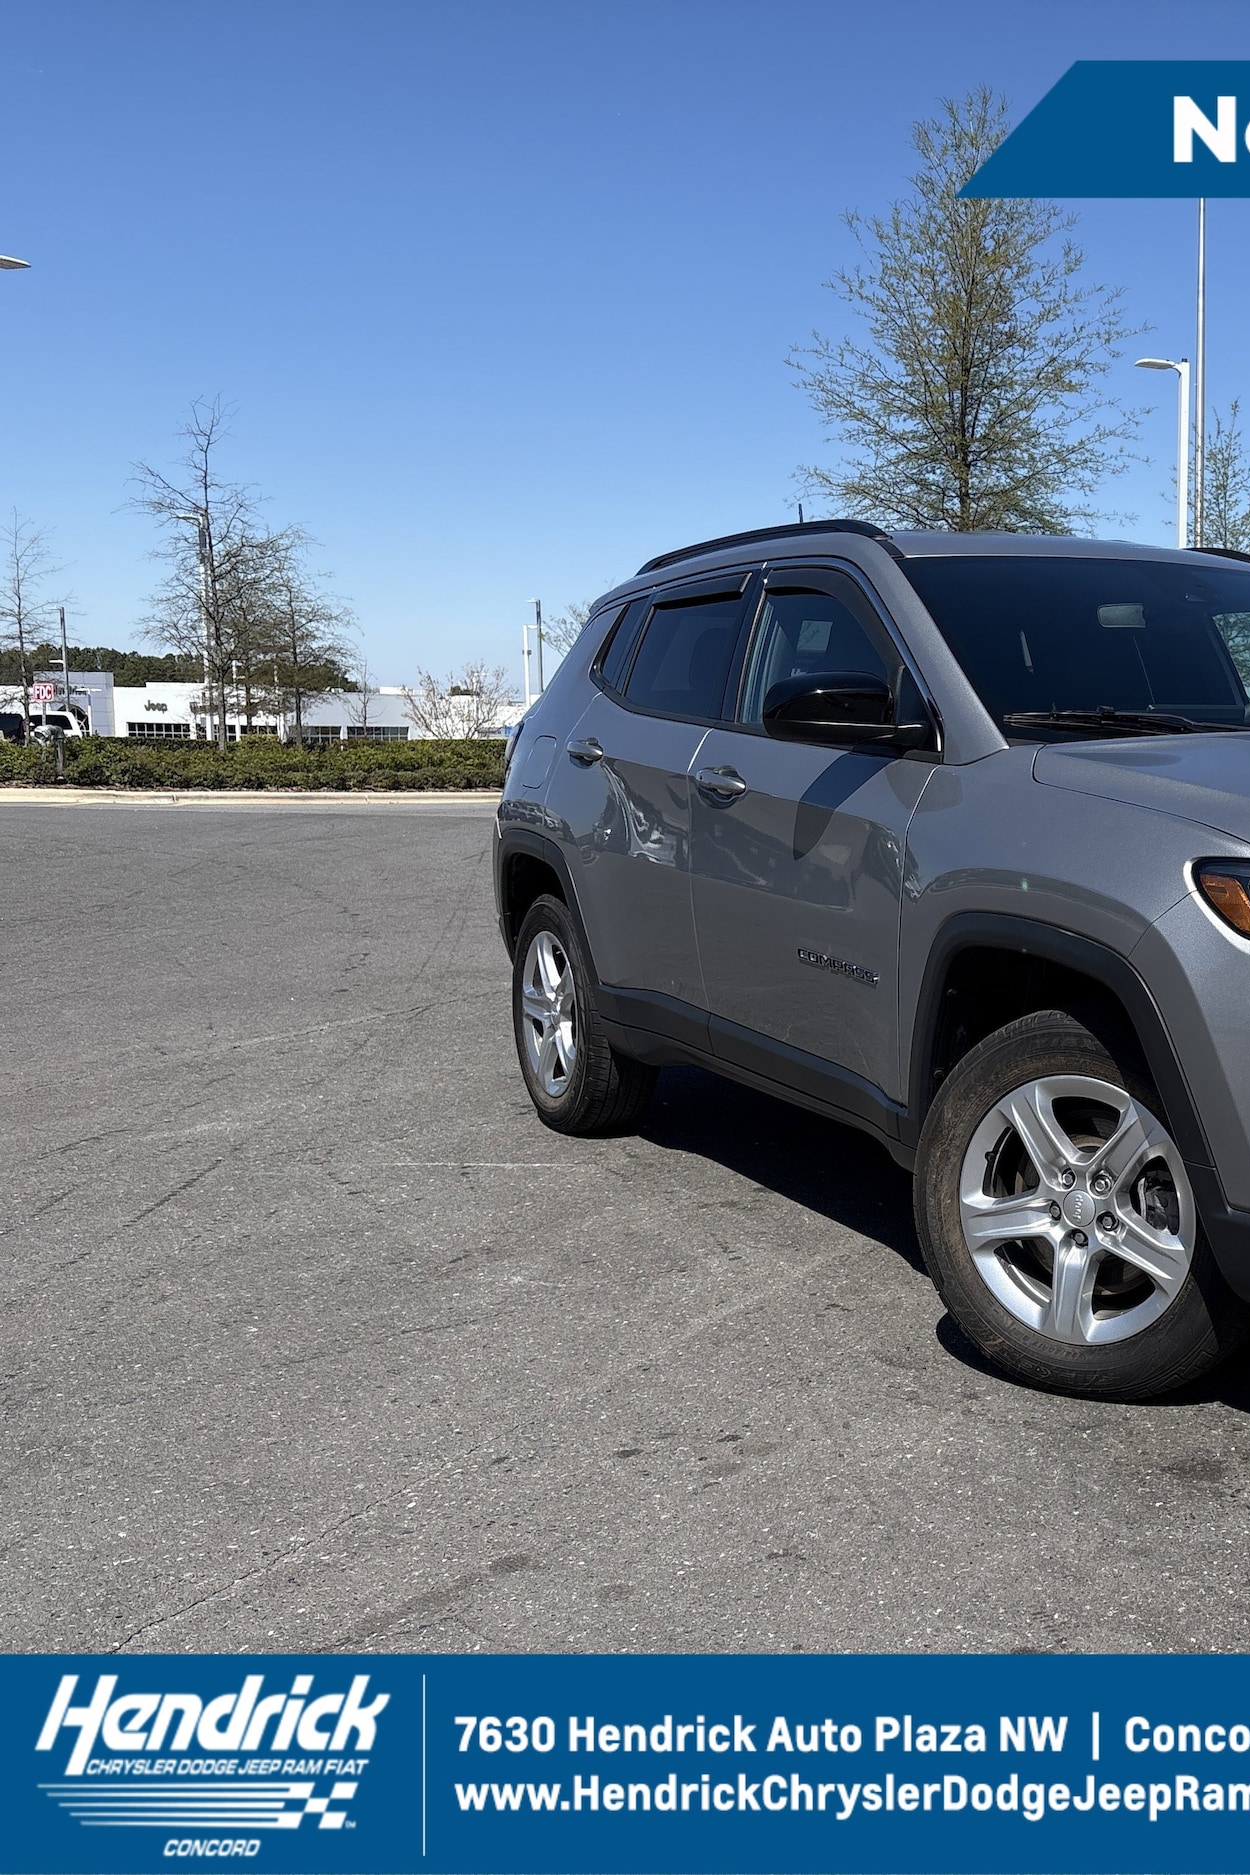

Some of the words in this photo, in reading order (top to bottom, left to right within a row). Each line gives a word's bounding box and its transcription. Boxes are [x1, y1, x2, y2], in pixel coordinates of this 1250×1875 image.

[34, 685, 52, 700] FDC
[144, 700, 168, 713] Jeep
[797, 947, 880, 984] COMPASS
